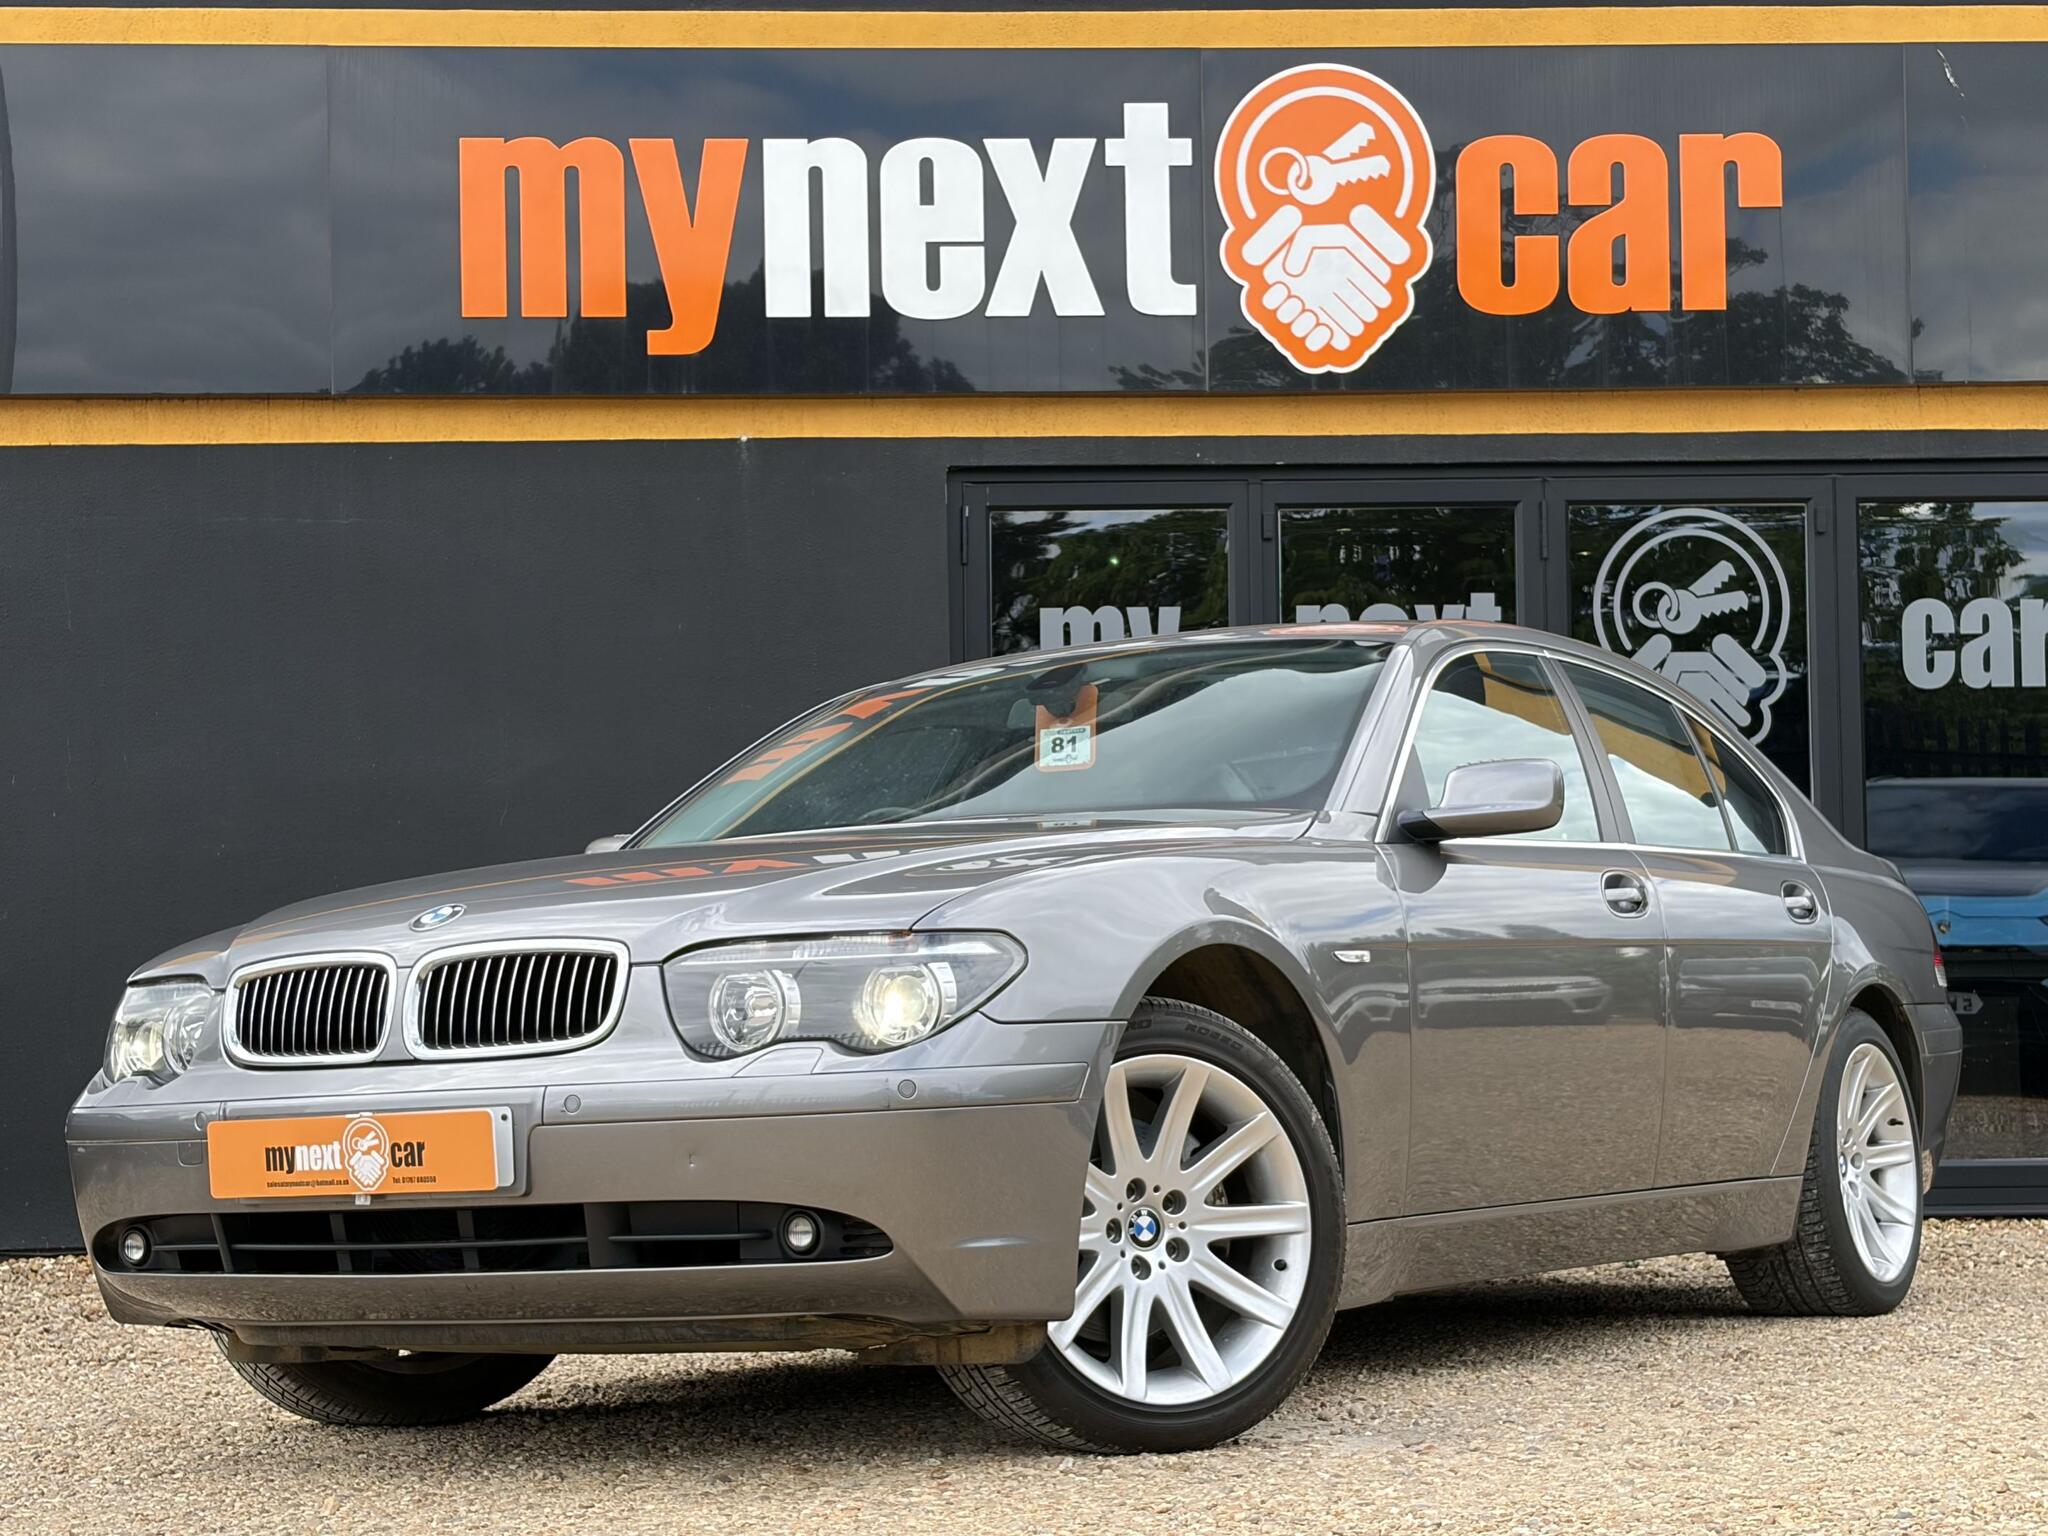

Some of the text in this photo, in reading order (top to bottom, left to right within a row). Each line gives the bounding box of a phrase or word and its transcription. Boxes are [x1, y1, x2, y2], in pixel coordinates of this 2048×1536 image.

[1457, 131, 1783, 316] car
[1050, 735, 1077, 753] 81
[390, 1142, 425, 1168] car
